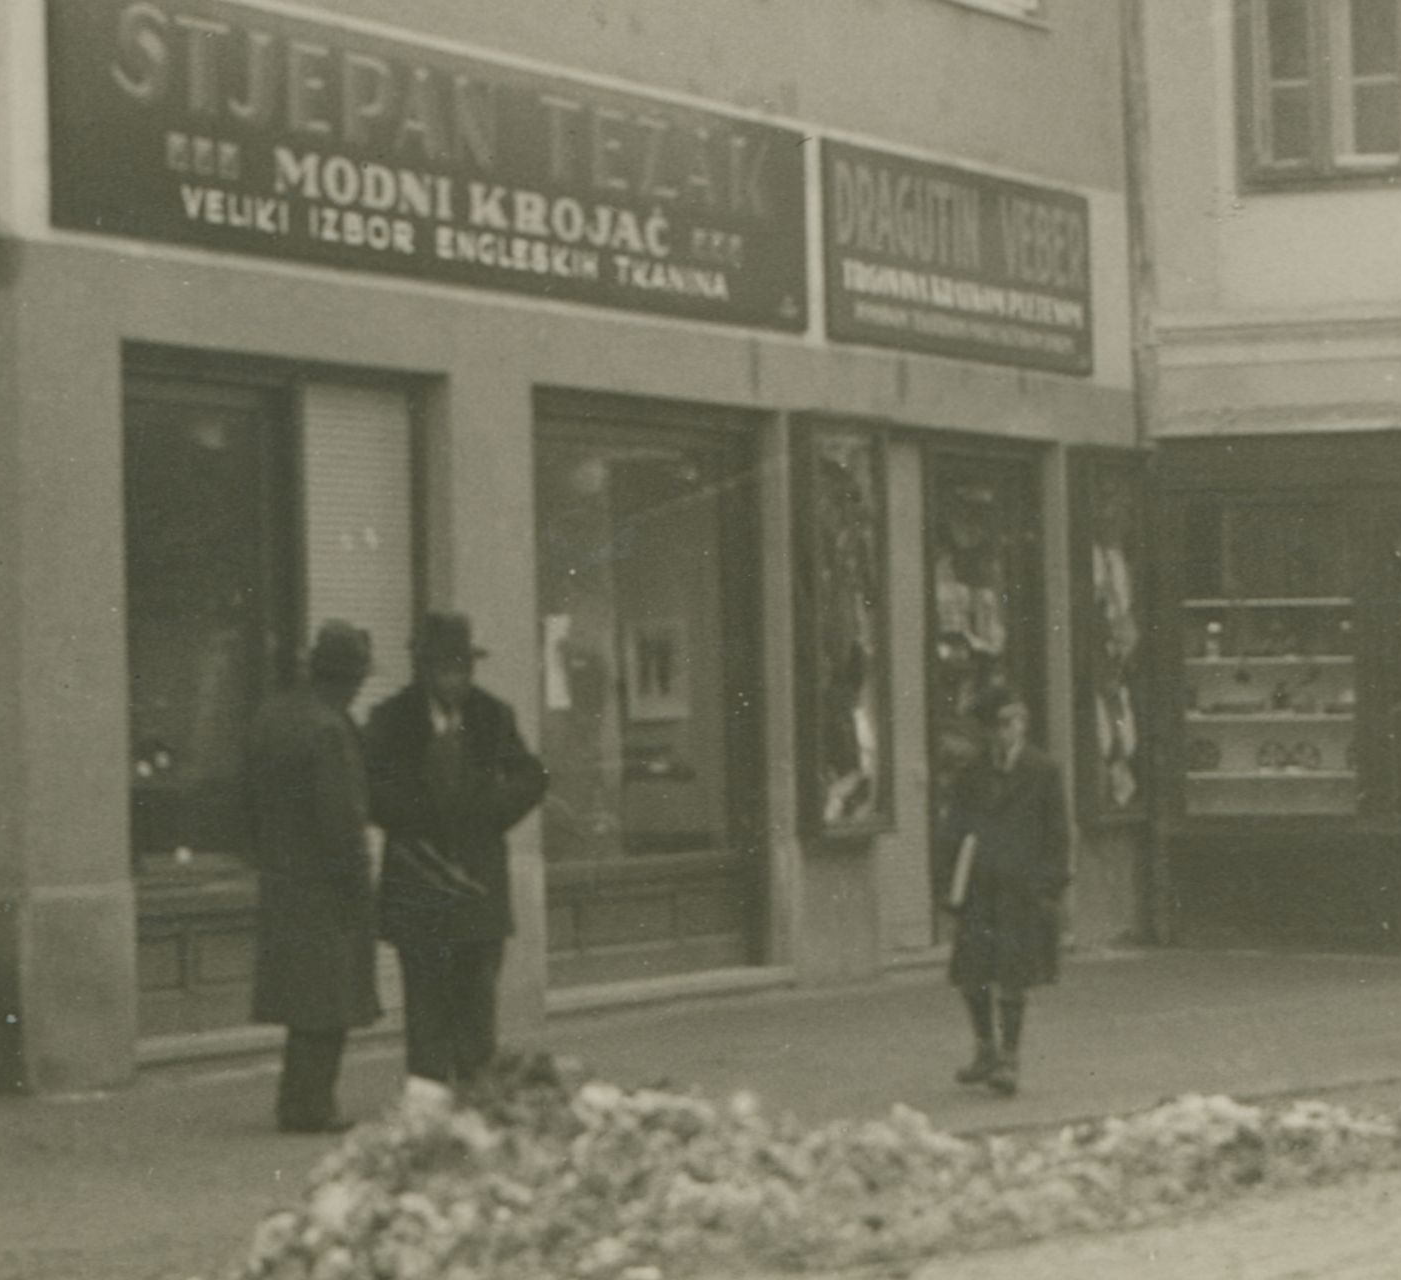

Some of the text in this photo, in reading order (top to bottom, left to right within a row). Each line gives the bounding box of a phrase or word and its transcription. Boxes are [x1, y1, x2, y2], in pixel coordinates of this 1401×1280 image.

[111, 1, 498, 170] STJEPAN
[180, 184, 730, 302] VELIKI IZBOR ENGLESKIH TKANINA
[274, 147, 671, 259] MODNI KROJAČ
[834, 158, 982, 274] DRAGUTIN
